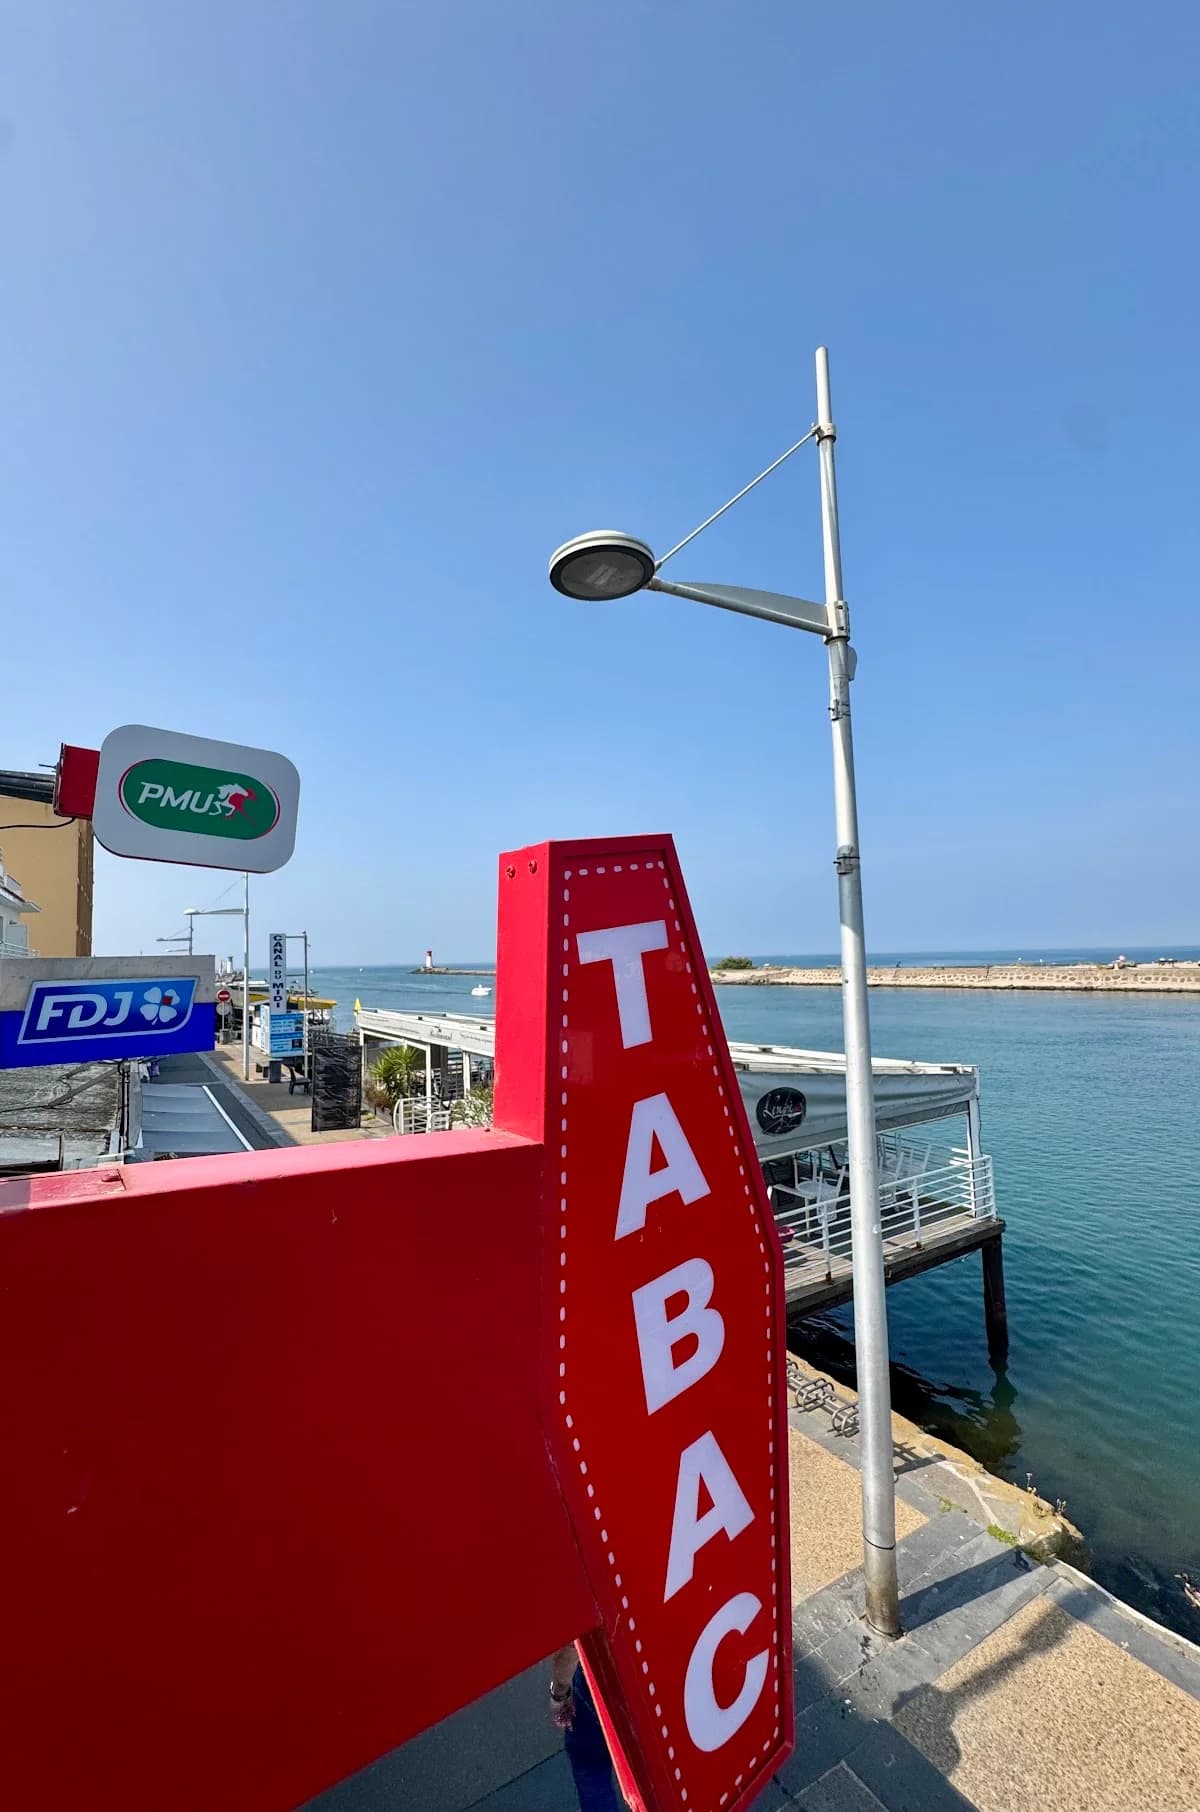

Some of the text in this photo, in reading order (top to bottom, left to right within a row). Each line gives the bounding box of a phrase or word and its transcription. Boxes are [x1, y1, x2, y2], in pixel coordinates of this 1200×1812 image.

[138, 782, 215, 813] PMU
[272, 935, 284, 1008] CANAL DU MIDI
[36, 991, 134, 1031] FDJ
[576, 919, 770, 1753] TABAC
